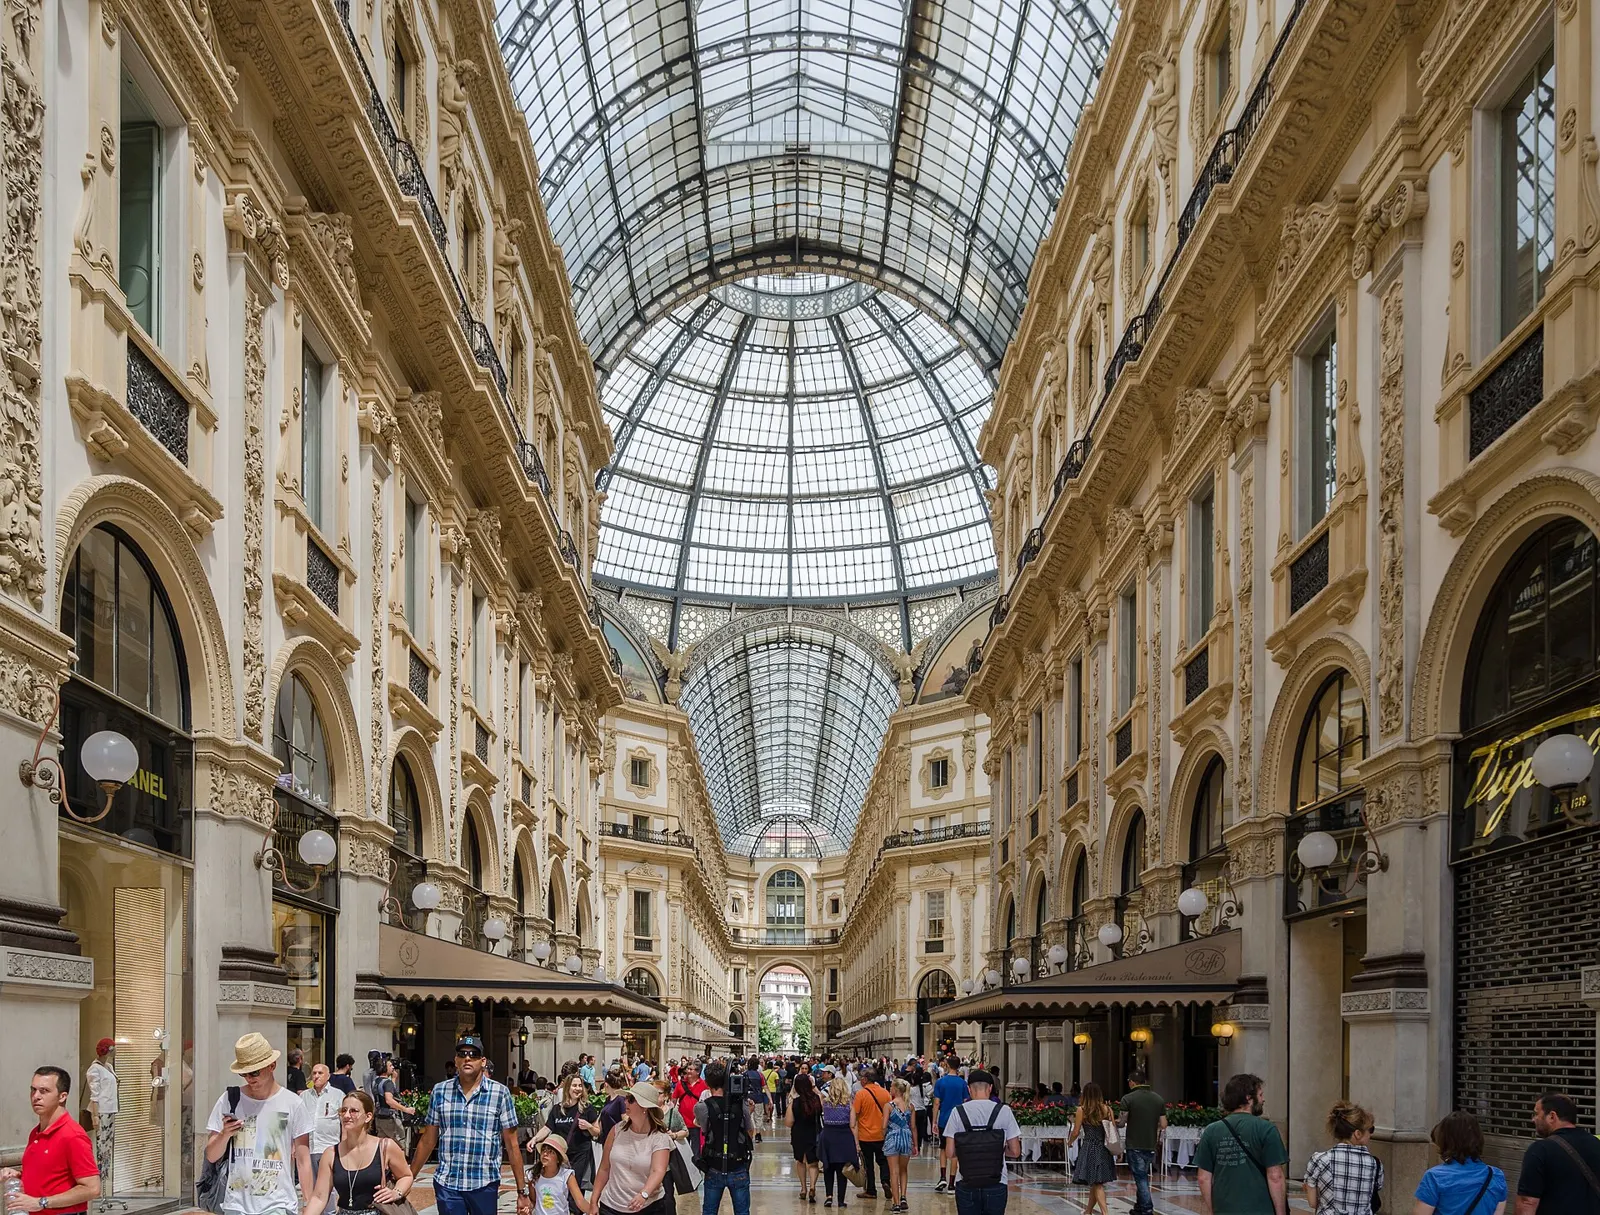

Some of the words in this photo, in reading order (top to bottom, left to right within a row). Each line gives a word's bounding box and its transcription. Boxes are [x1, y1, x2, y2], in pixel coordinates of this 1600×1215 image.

[127, 768, 168, 800] ANEL
[1190, 950, 1220, 973] Biffi
[1095, 972, 1117, 981] Bar
[1120, 970, 1174, 981] Ristorante
[252, 1159, 260, 1168] MY
[261, 1159, 283, 1170] HOMIES
